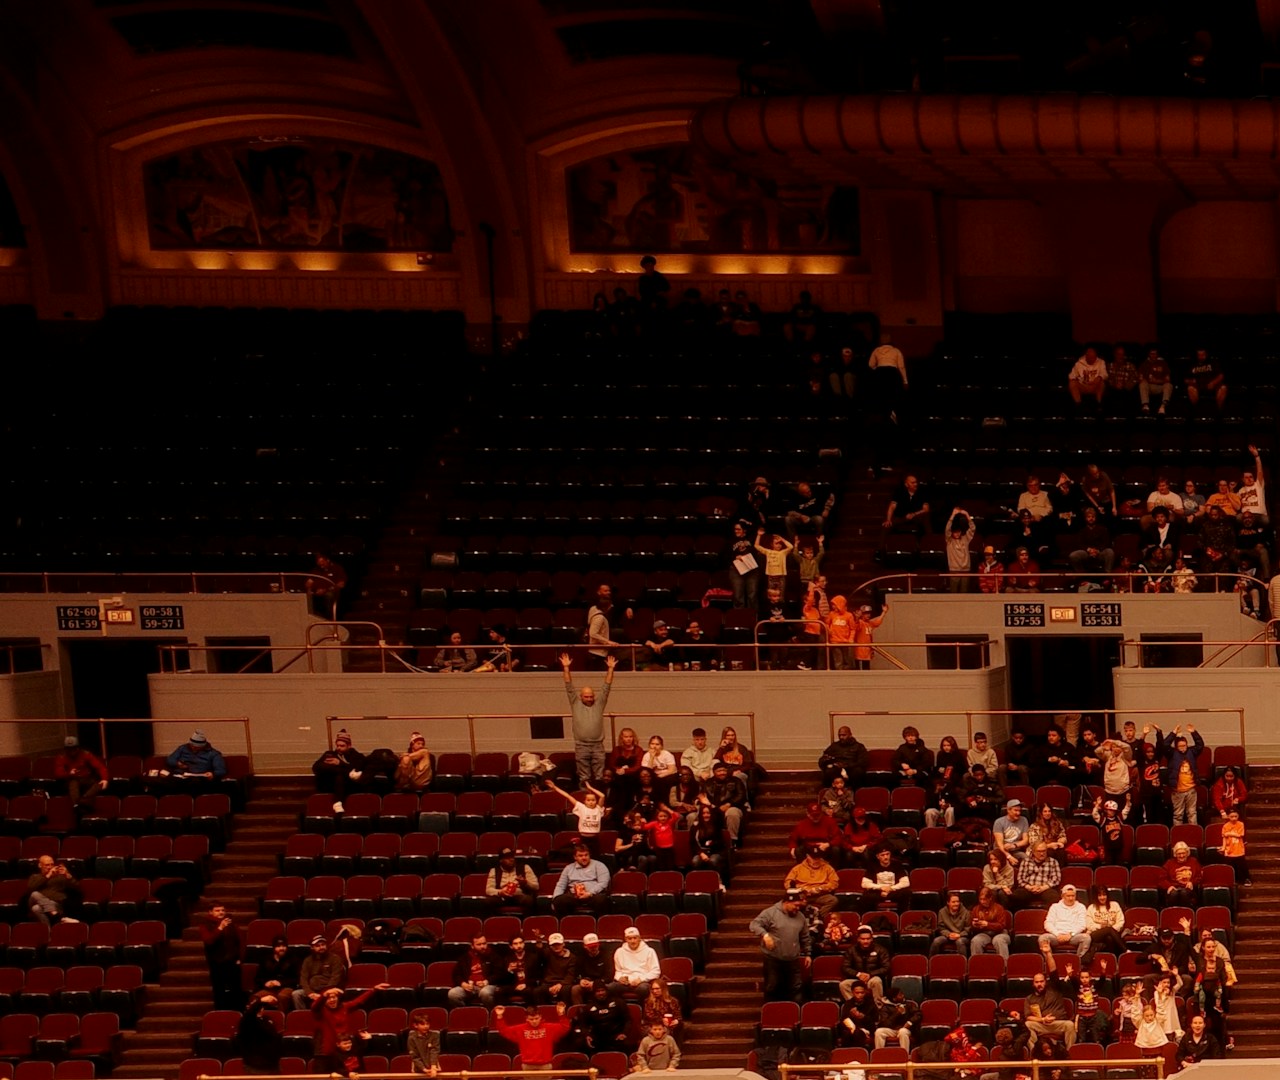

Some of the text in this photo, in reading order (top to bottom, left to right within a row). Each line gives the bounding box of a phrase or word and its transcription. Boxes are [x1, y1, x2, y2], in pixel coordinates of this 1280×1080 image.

[66, 608, 97, 617] 62-60
[143, 608, 174, 617] 60-58
[1012, 605, 1042, 614] 58-56
[1083, 605, 1112, 614] 56-54
[111, 612, 128, 621] EXIT
[1054, 610, 1071, 619] EXIT
[68, 620, 98, 629] 61-59
[145, 620, 174, 629] 59-57
[1013, 617, 1041, 625] 57-55
[1084, 617, 1113, 625] 55-53
